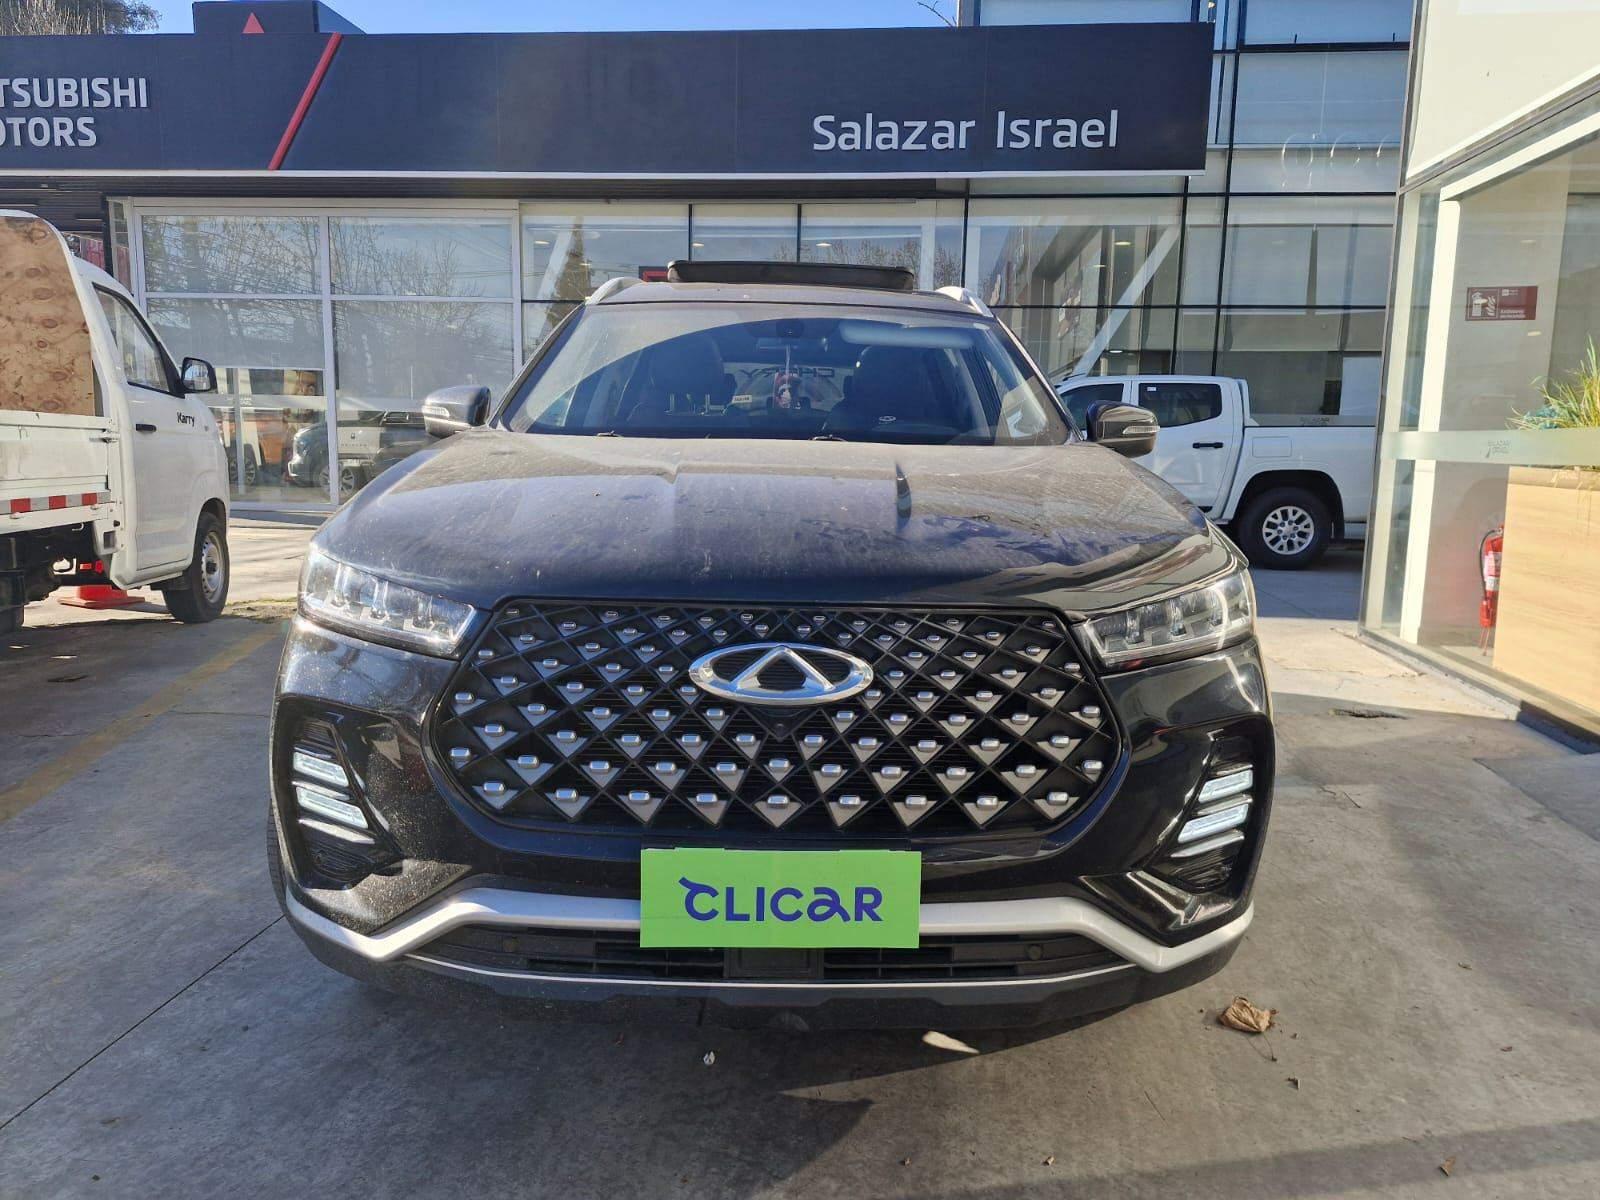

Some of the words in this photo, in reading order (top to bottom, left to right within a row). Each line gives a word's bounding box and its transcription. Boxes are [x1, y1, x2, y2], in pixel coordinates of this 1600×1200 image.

[0, 116, 97, 147] TORS
[812, 112, 976, 150] Salazar
[996, 109, 1119, 149] Israel
